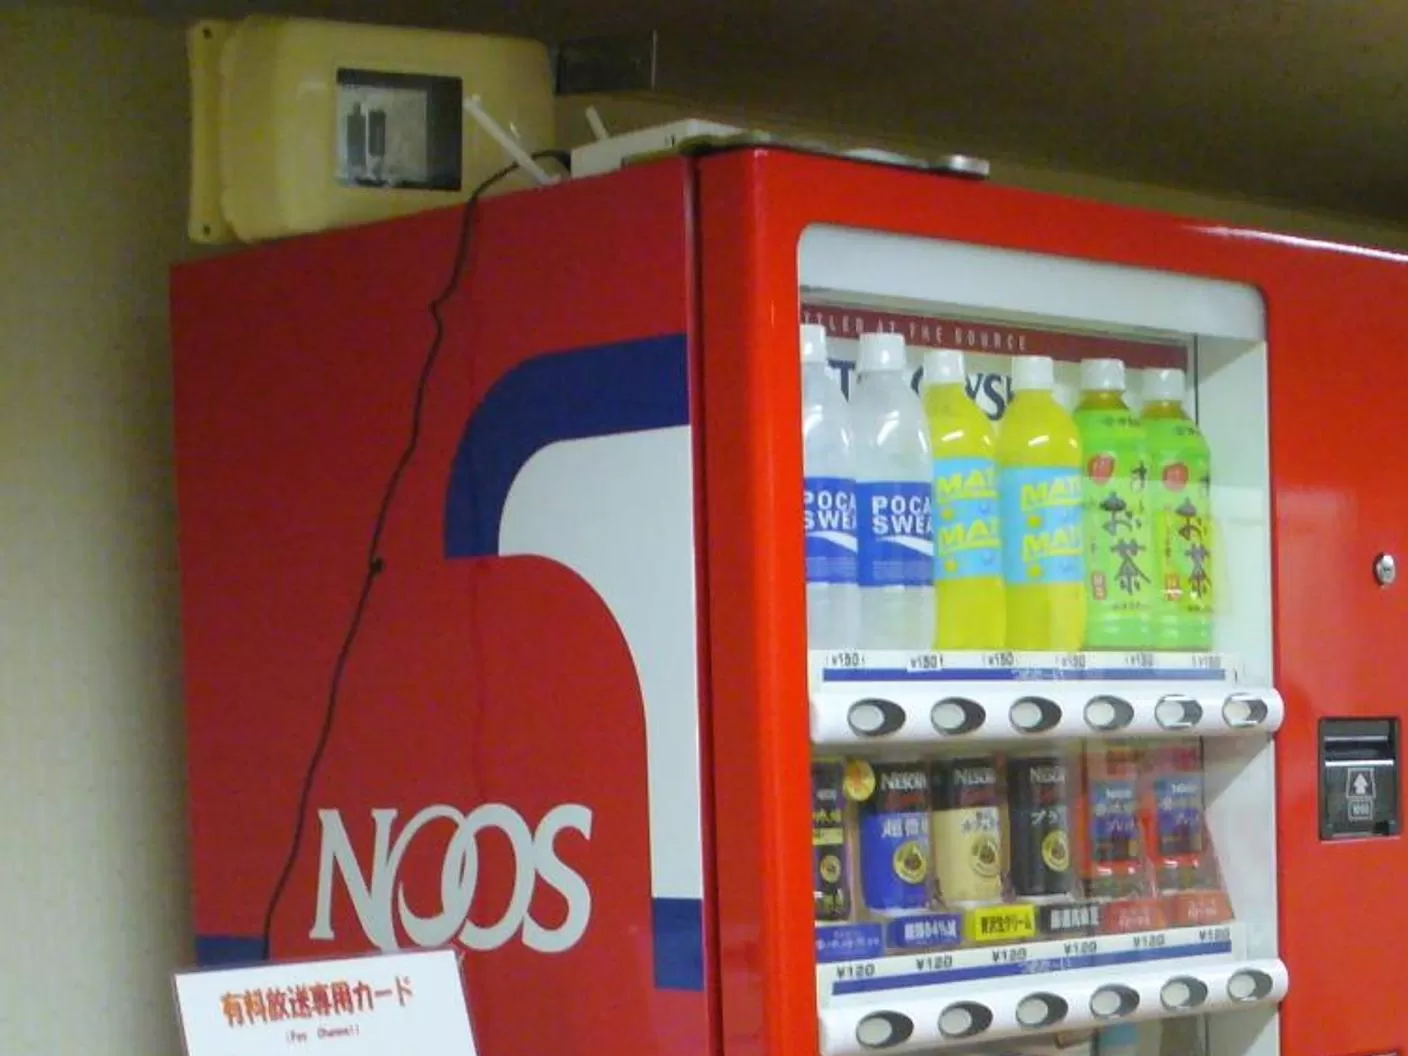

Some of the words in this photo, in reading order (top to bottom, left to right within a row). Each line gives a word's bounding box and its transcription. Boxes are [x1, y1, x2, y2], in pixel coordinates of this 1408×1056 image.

[909, 322, 943, 343] THE
[954, 327, 1027, 352] SOURCE
[309, 803, 593, 953] NOOS
[916, 955, 953, 971] ¥120
[992, 947, 1027, 963] ¥120
[837, 963, 875, 979] ¥120
[220, 974, 413, 1028] 有料放送専用カード
